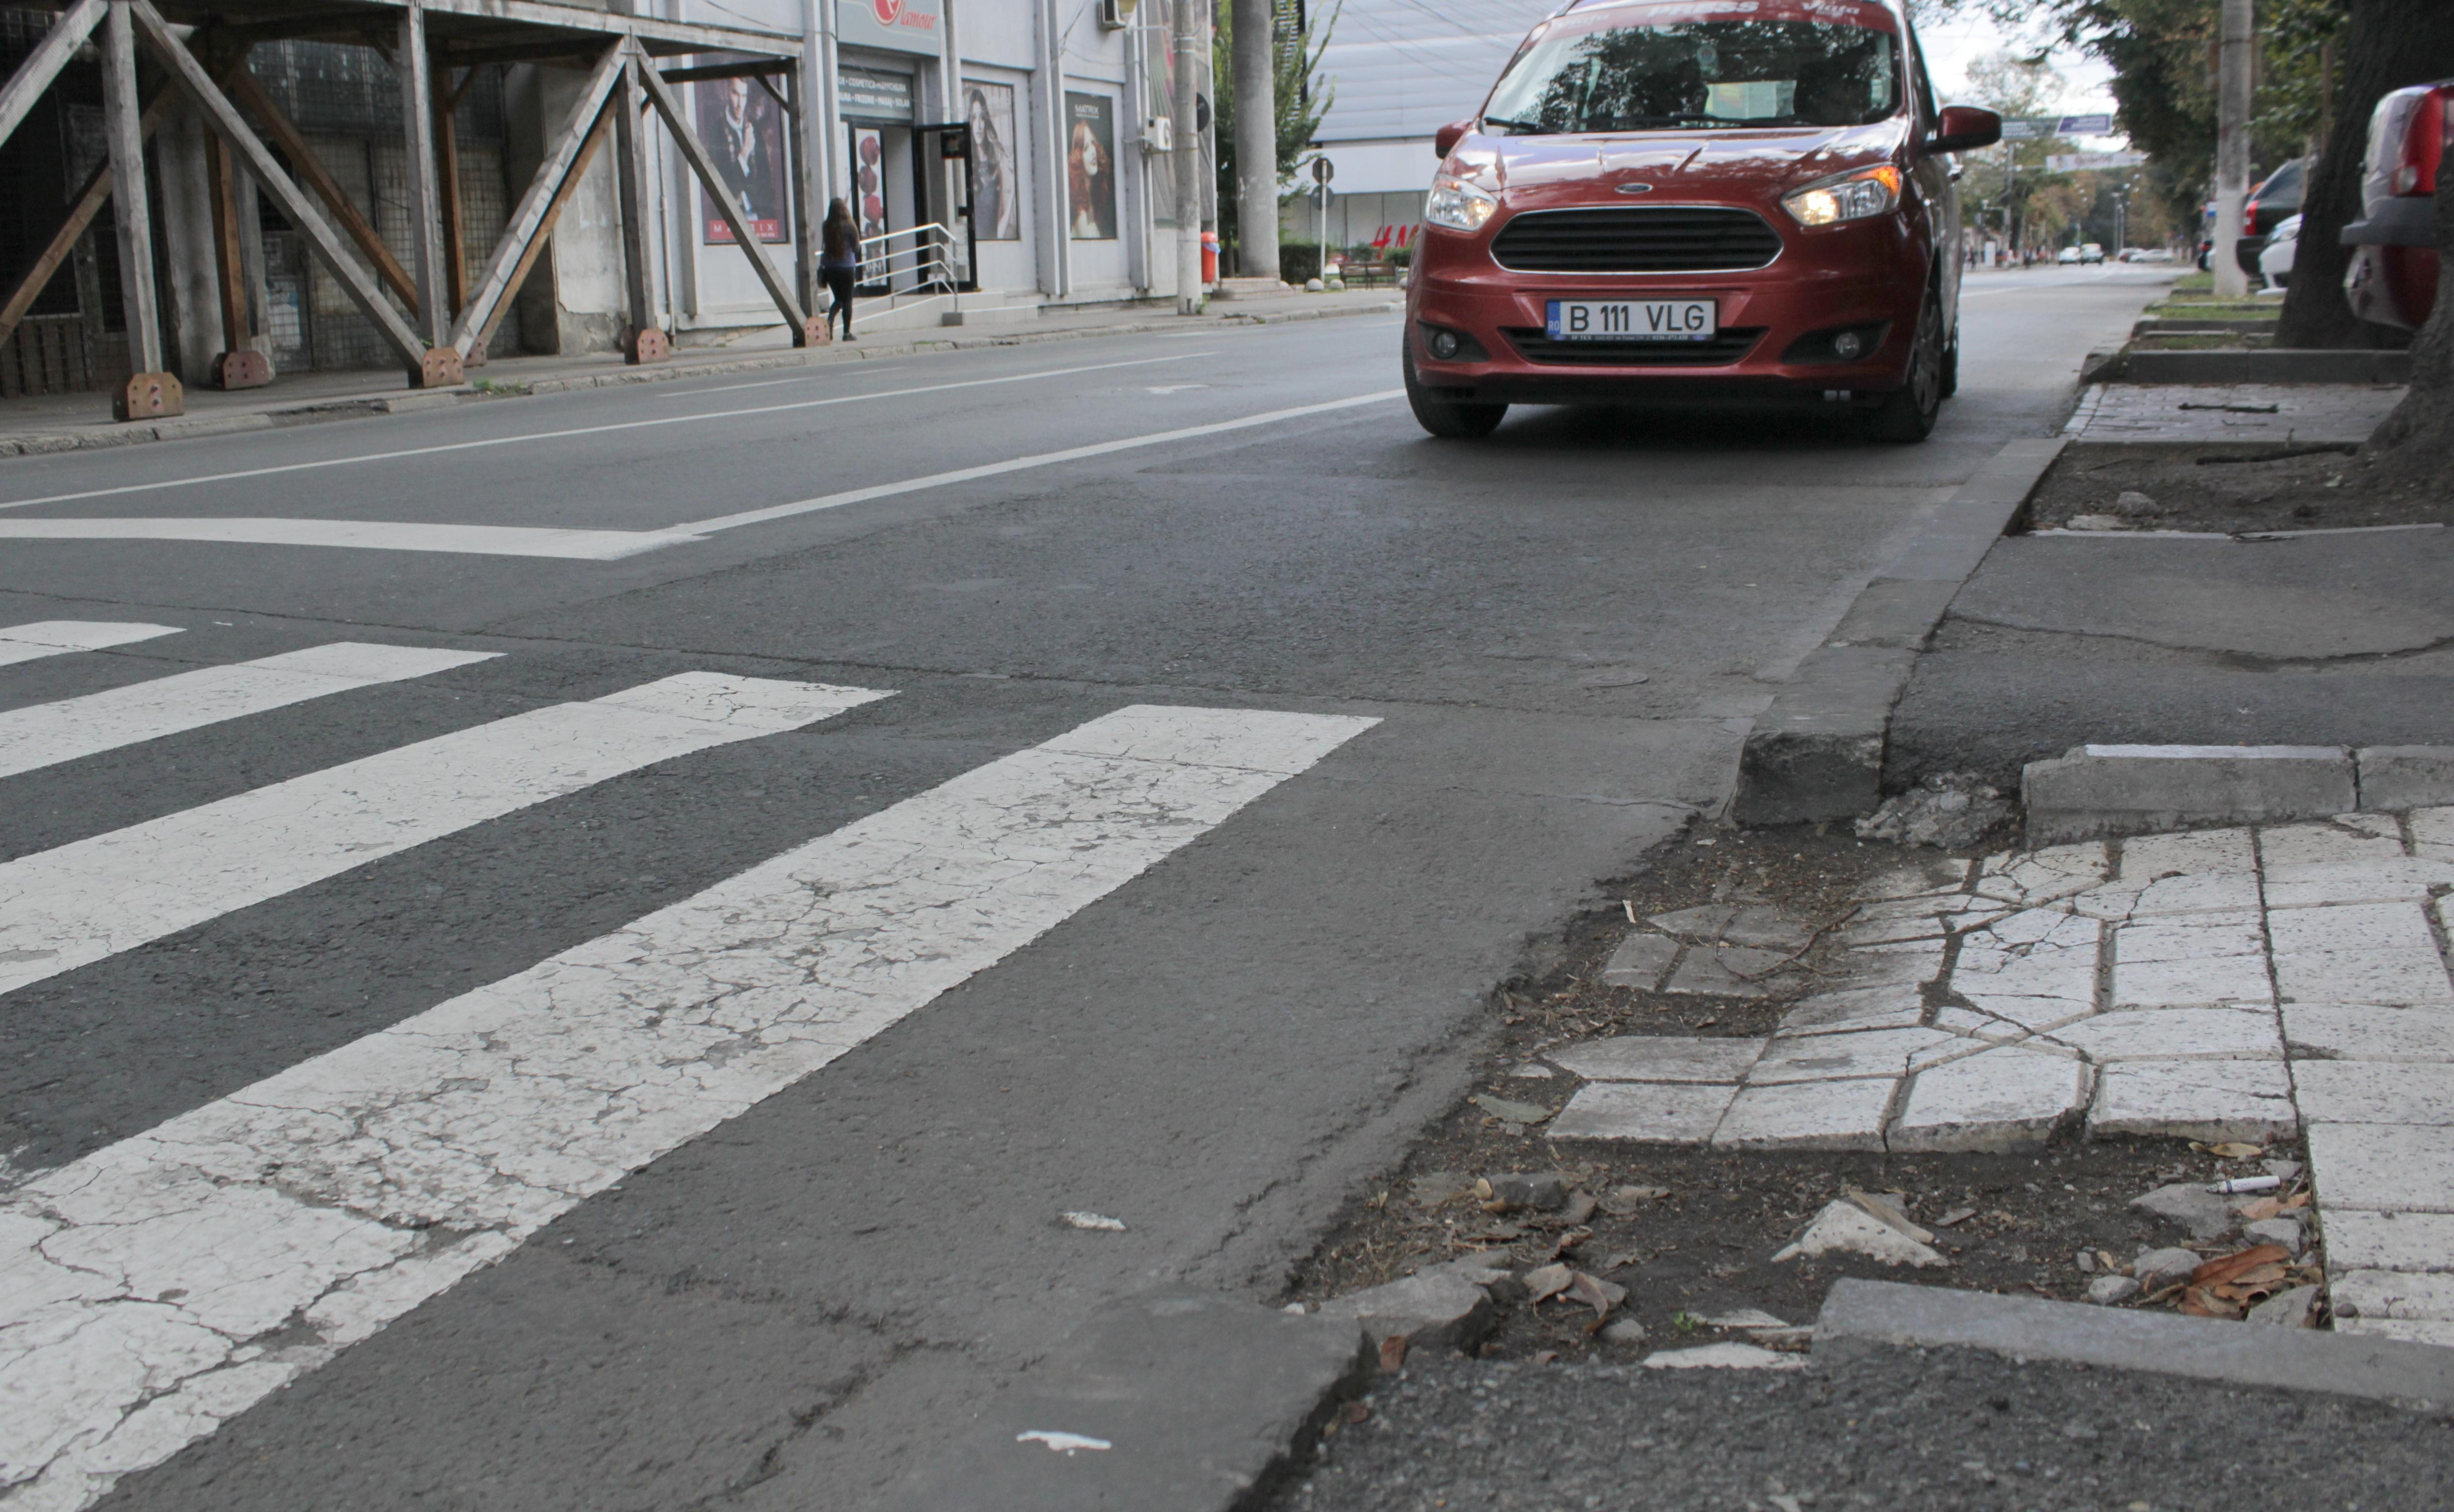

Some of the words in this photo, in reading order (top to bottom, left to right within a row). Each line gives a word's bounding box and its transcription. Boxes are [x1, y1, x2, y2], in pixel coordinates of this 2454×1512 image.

[1647, 1, 1760, 17] PRESS
[1075, 104, 1099, 115] MATRIX
[1570, 306, 1589, 332] B
[1600, 305, 1629, 332] 111
[1646, 305, 1705, 332] VLG
[1548, 320, 1560, 331] RO
